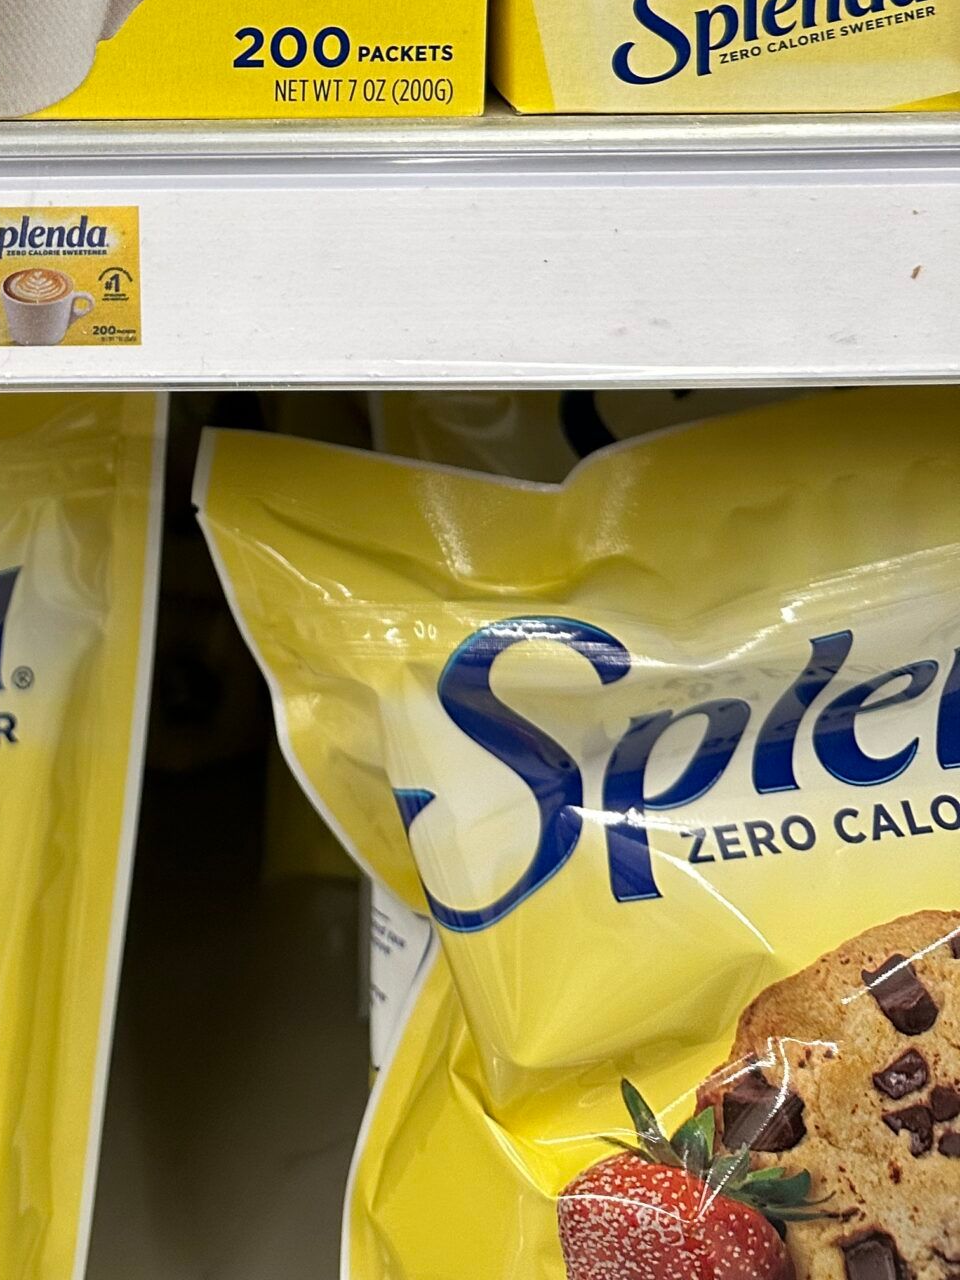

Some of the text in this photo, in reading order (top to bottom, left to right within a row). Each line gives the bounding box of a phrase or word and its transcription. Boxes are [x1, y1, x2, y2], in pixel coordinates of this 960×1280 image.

[233, 26, 453, 68] 200 PACKETS
[719, 5, 936, 64] ZERO CALORIE SWEETENER
[275, 78, 453, 104] NET WT 7 OZ (200G)
[104, 273, 120, 292] #1
[92, 325, 116, 335] 200
[392, 615, 960, 933] Sple
[680, 794, 960, 864] ZERO CALO
